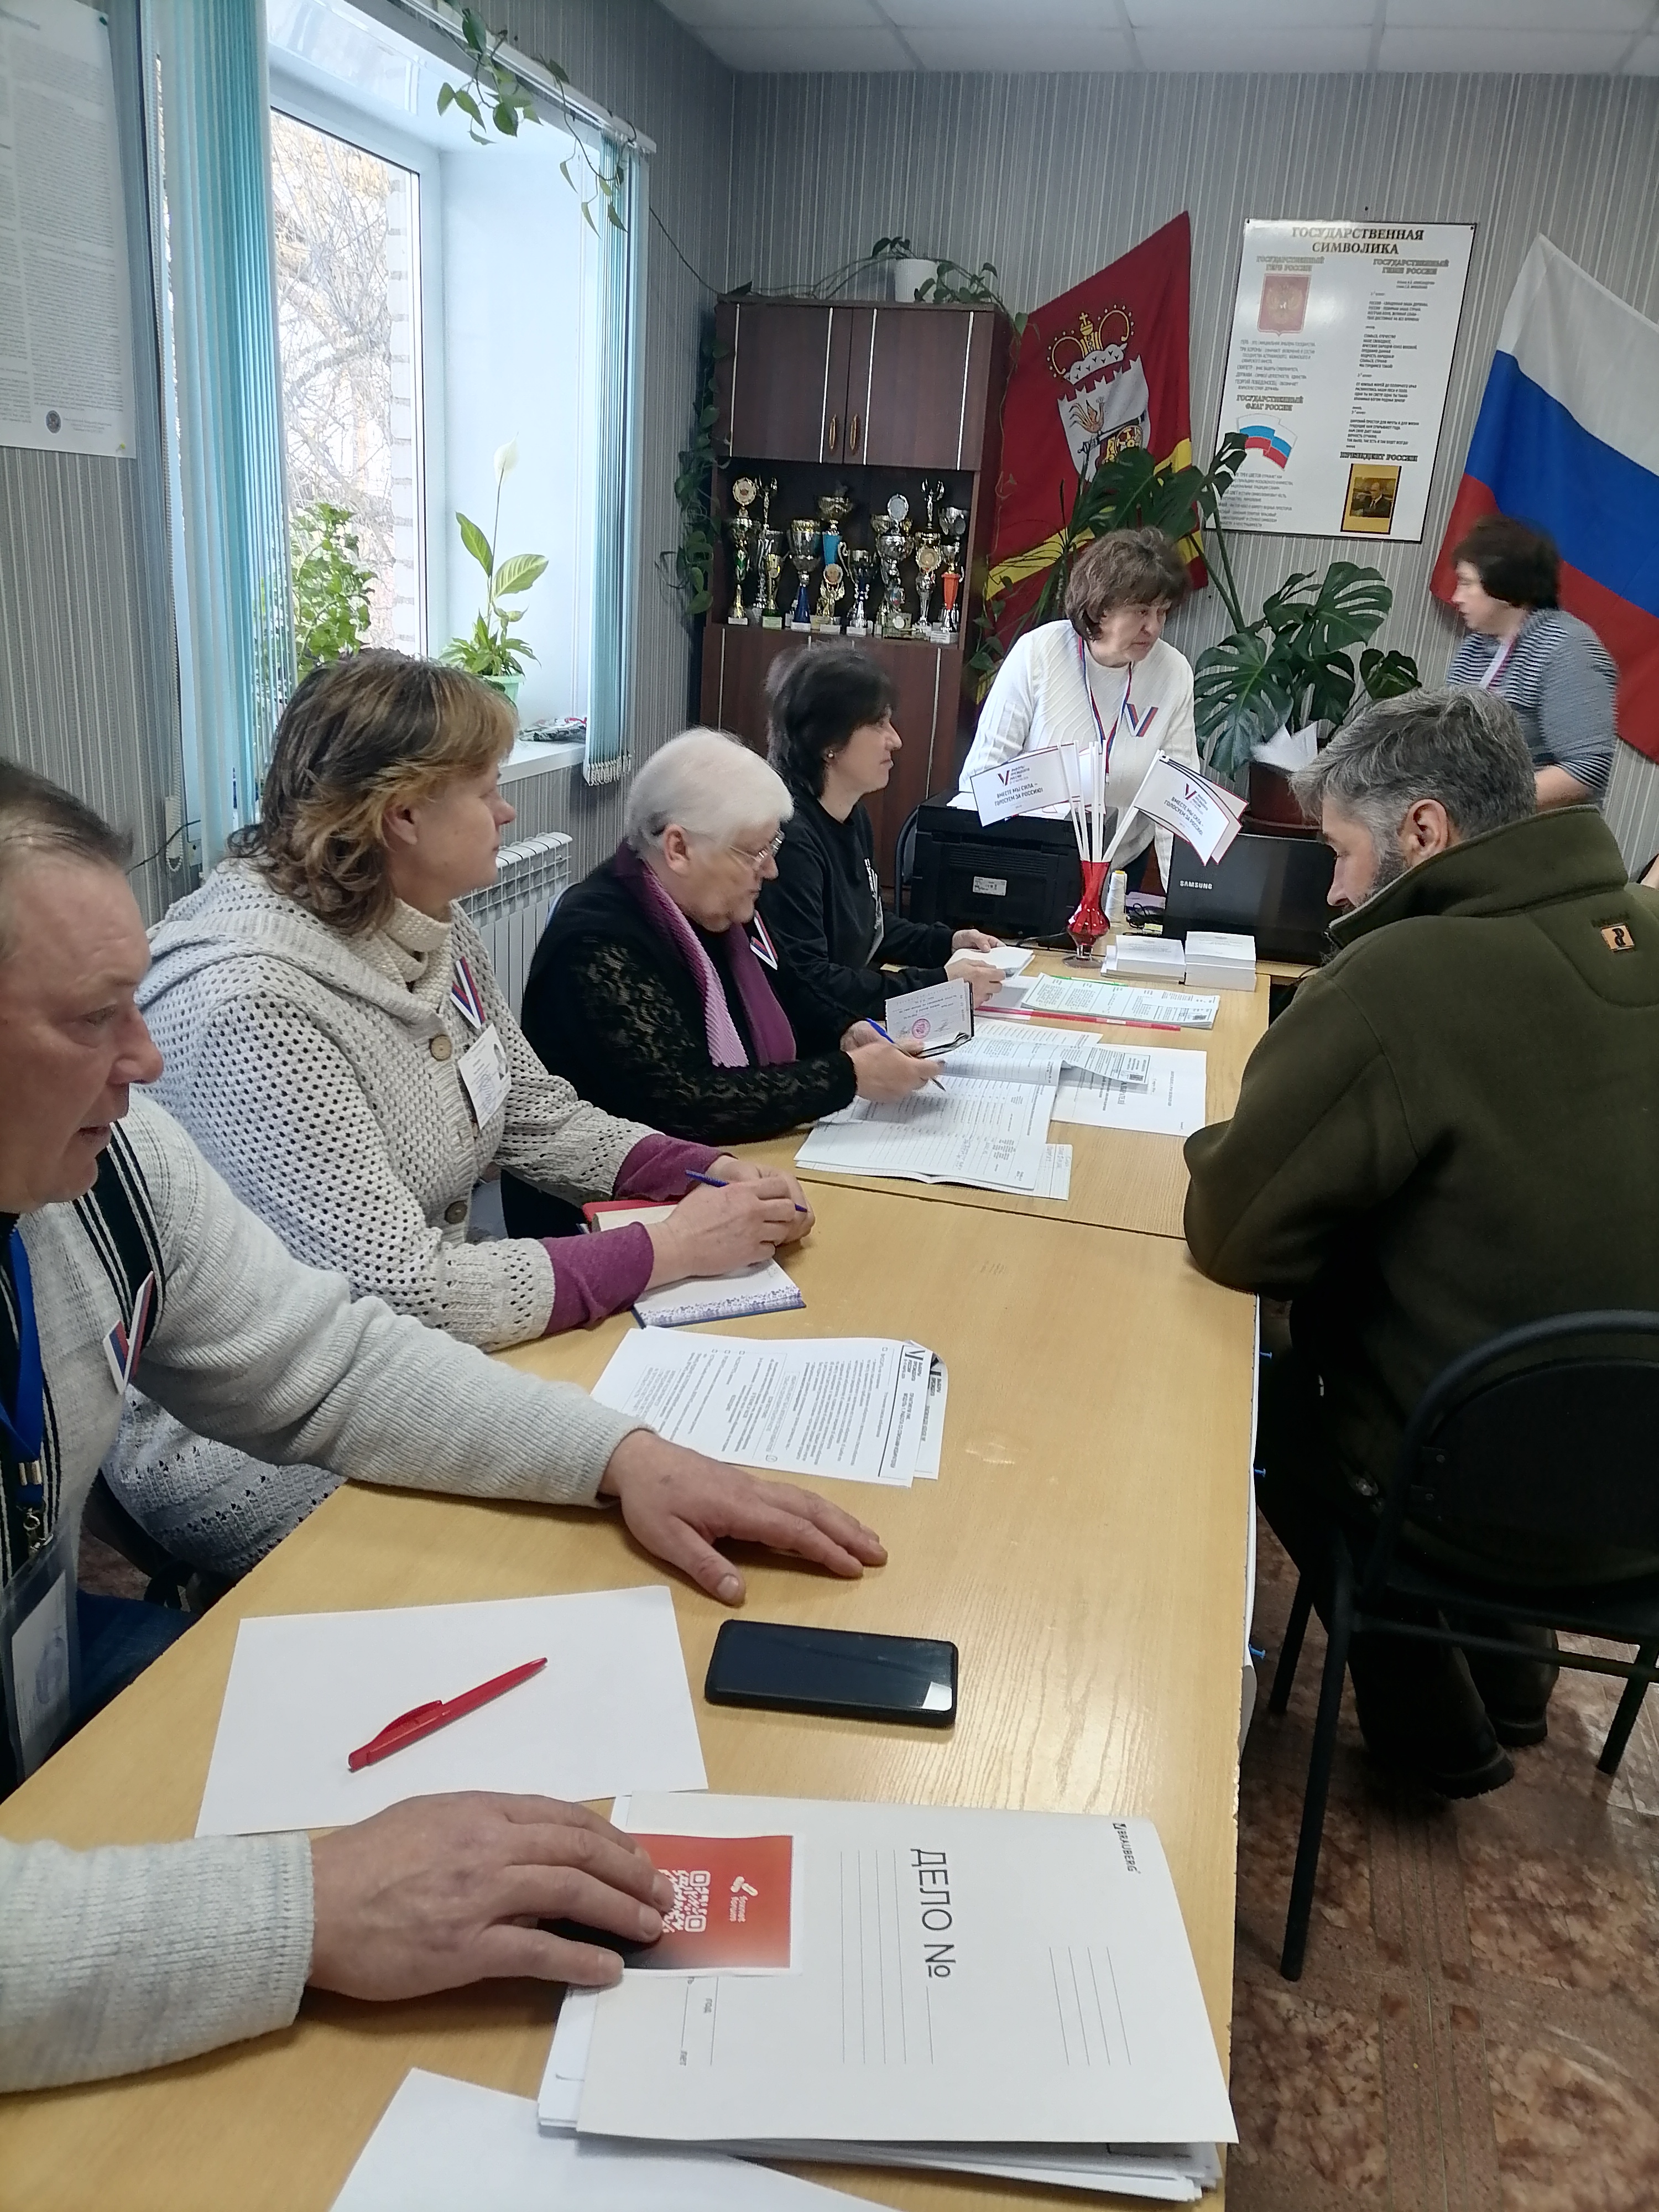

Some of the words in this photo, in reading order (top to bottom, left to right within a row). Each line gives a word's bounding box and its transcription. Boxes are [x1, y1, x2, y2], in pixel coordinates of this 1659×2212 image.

[1292, 227, 1424, 241] ГОСУДАРСТВЕННАЯ
[1312, 242, 1400, 255] СИМВОЛИКА
[1373, 258, 1449, 267] ГОСУДАРСТВЕННЫЙ
[1236, 395, 1303, 404] ГОСУДАРСТВЕННЫЙ
[994, 795, 1015, 806] ГОЛОСУЕМ
[1021, 787, 1044, 798] РОССИЮ!
[997, 789, 1012, 799] ВМЕСТЕ
[1164, 800, 1186, 817] ГОЛОСУЕМ
[1171, 796, 1187, 810] ВМЕСТЕ
[1187, 808, 1194, 816] МЫ
[1180, 880, 1213, 890] SAMSUNG
[1117, 1830, 1138, 1872] BRAUBERG
[910, 1848, 953, 1931] ДЕЛО
[924, 1944, 957, 1978] №
[703, 1998, 713, 2013] год
